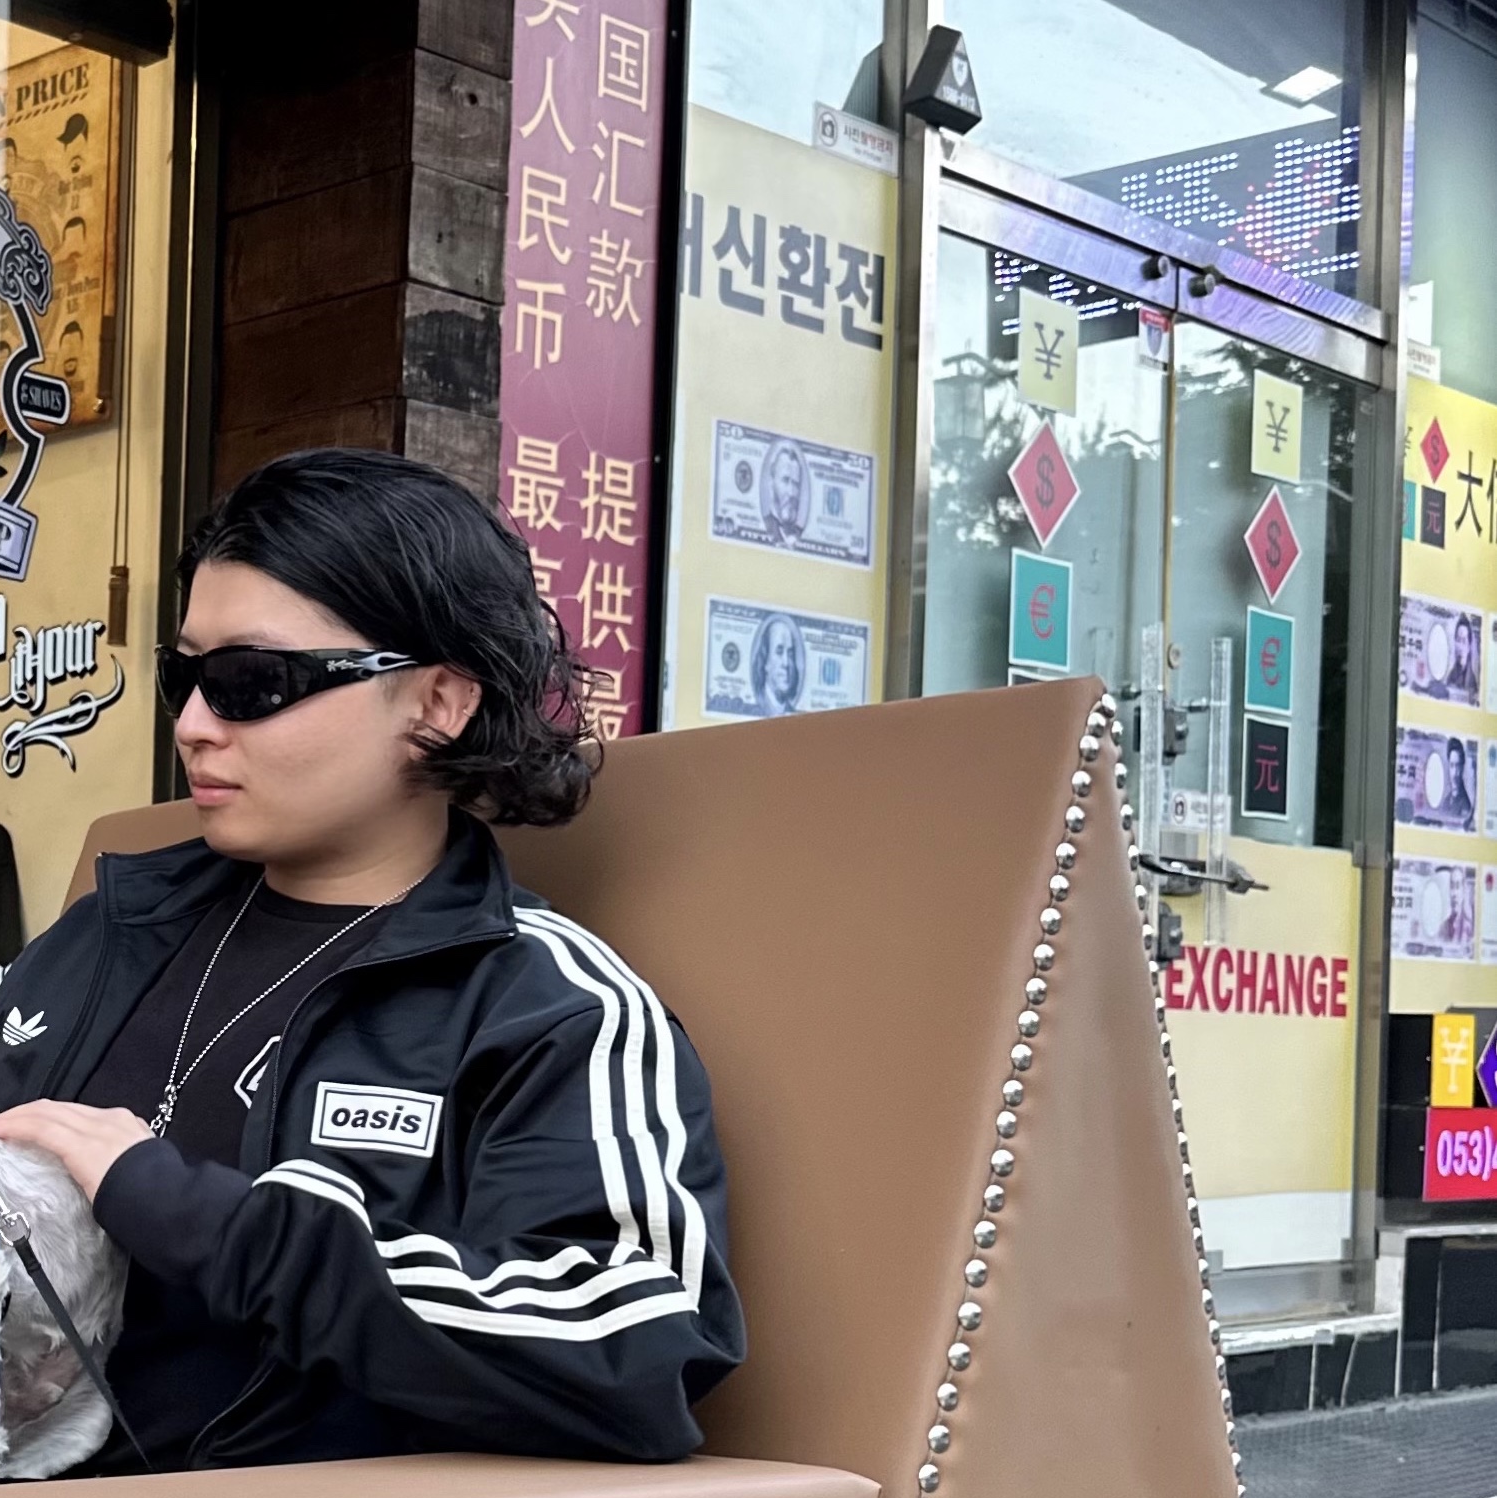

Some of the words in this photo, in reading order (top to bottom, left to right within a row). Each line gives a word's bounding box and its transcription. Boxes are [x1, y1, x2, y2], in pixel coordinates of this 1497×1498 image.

[16, 62, 90, 112] PRICE
[586, 13, 650, 327] 国汇款
[1254, 743, 1280, 793] 元
[1165, 945, 1349, 1018] EXCHANGE
[330, 1104, 422, 1135] oasis
